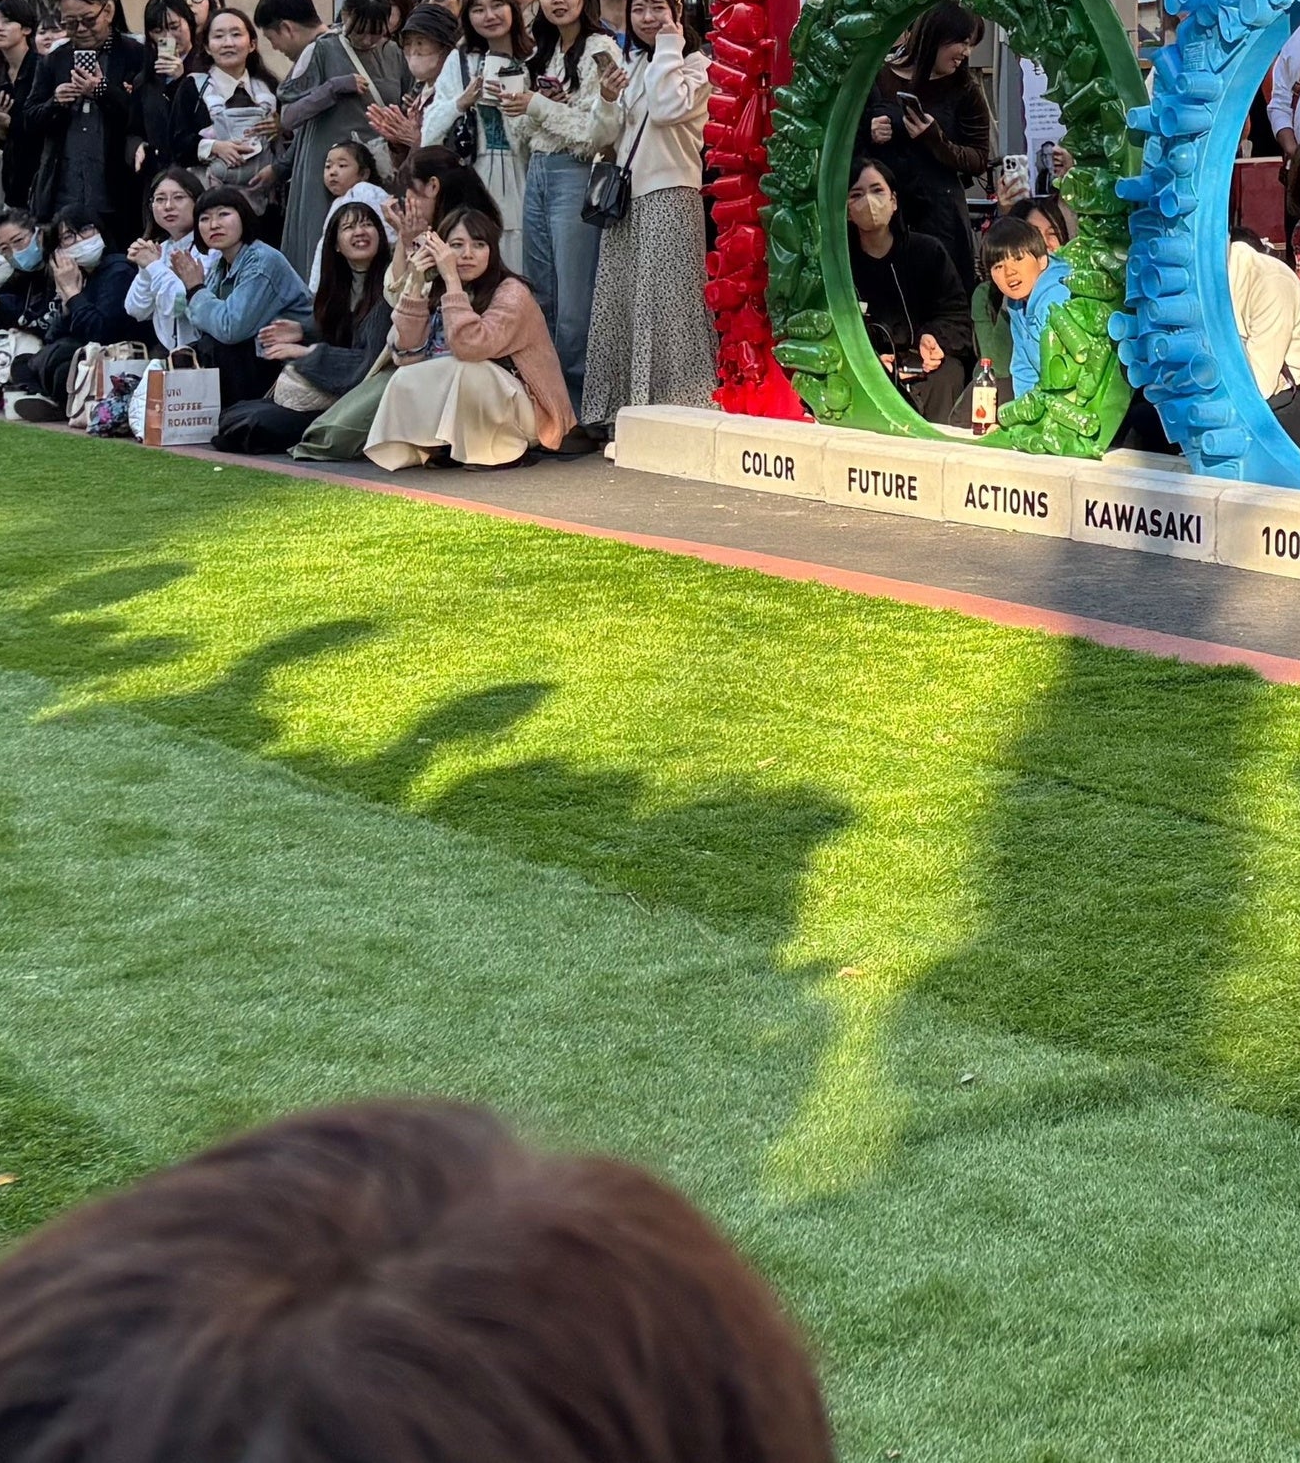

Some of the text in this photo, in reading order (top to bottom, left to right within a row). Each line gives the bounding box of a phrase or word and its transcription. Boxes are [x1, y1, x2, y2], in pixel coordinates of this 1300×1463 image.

[167, 402, 203, 412] COFFEE
[742, 450, 795, 482] COLOR
[848, 467, 918, 501] FUTURE
[964, 482, 1049, 519] ACTIONS
[1085, 498, 1202, 545] KAWASAKI
